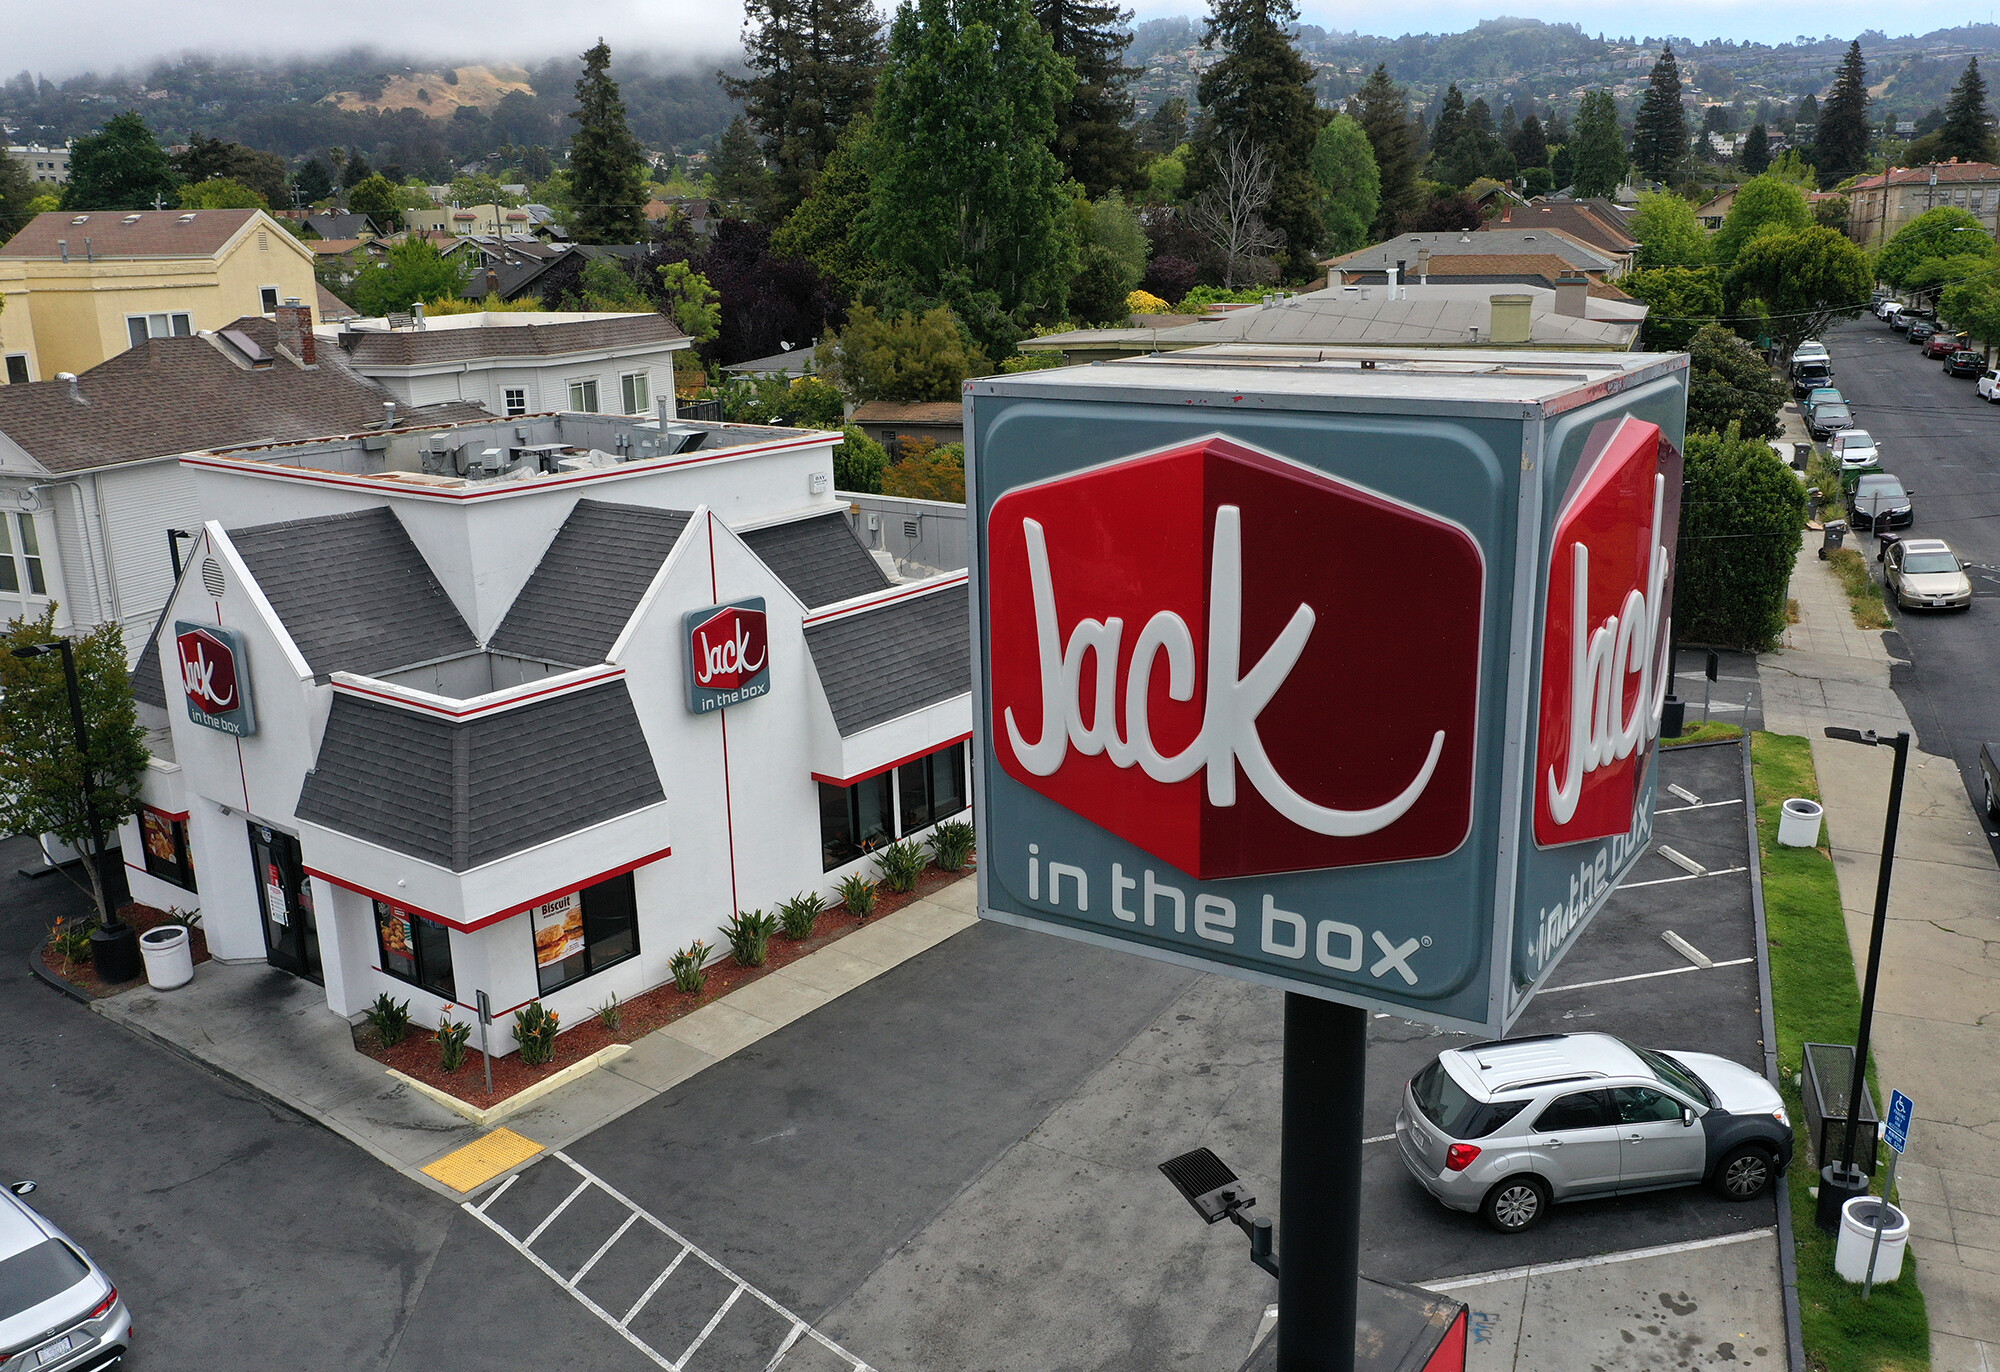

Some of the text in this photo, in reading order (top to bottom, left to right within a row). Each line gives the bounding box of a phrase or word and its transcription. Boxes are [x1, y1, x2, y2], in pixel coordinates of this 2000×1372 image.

[179, 641, 233, 706] Jack
[698, 618, 766, 684] Jack
[1004, 504, 1445, 837] Jack
[1547, 472, 1671, 826] Jack
[191, 708, 241, 734] in the box
[702, 684, 765, 710] in the box
[541, 896, 571, 916] Biscuit
[1027, 843, 1089, 913] in
[1111, 863, 1236, 946] the
[1569, 847, 1608, 931] the
